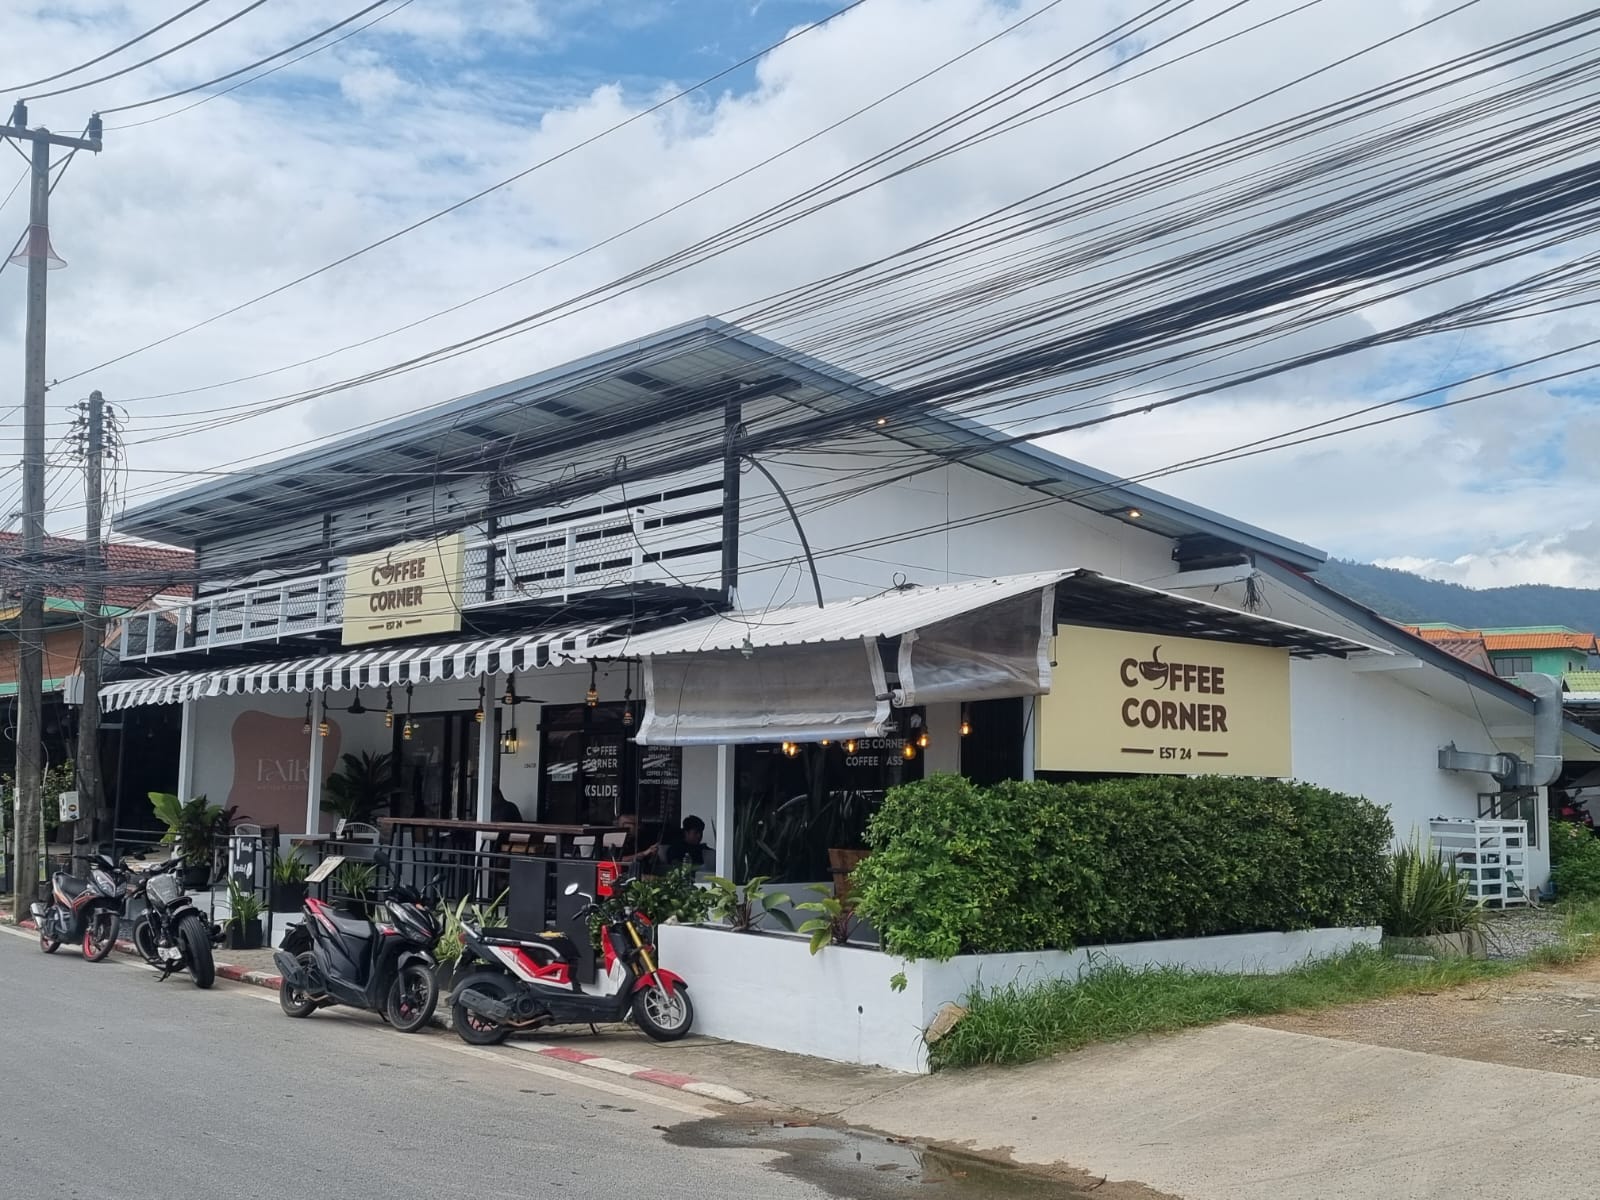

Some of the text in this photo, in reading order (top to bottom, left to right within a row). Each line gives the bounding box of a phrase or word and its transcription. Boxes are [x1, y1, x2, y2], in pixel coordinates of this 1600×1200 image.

[369, 586, 423, 612] CORNER
[386, 621, 395, 630] EST
[1120, 645, 1225, 695] COFFEE
[1121, 697, 1228, 733] CORNER
[1160, 747, 1192, 760] EST 24
[846, 756, 879, 767] COFFEE
[591, 785, 618, 797] SLIDE
